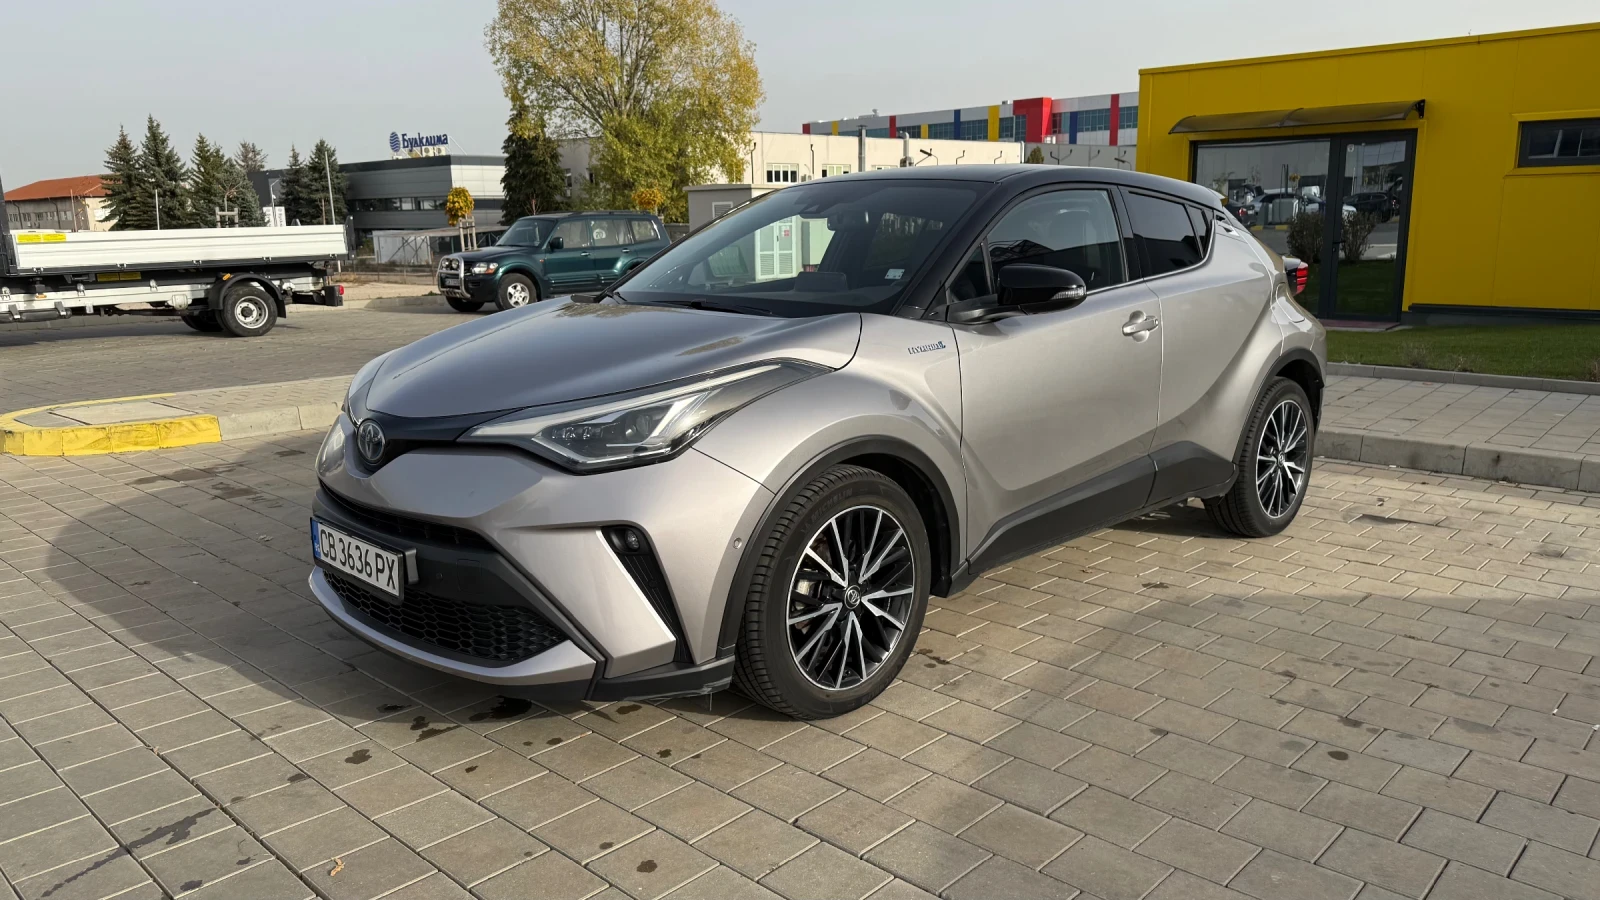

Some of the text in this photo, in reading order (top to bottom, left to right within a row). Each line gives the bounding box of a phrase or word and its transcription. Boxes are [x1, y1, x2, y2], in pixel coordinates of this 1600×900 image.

[320, 529, 396, 590] CB 3636 PX
